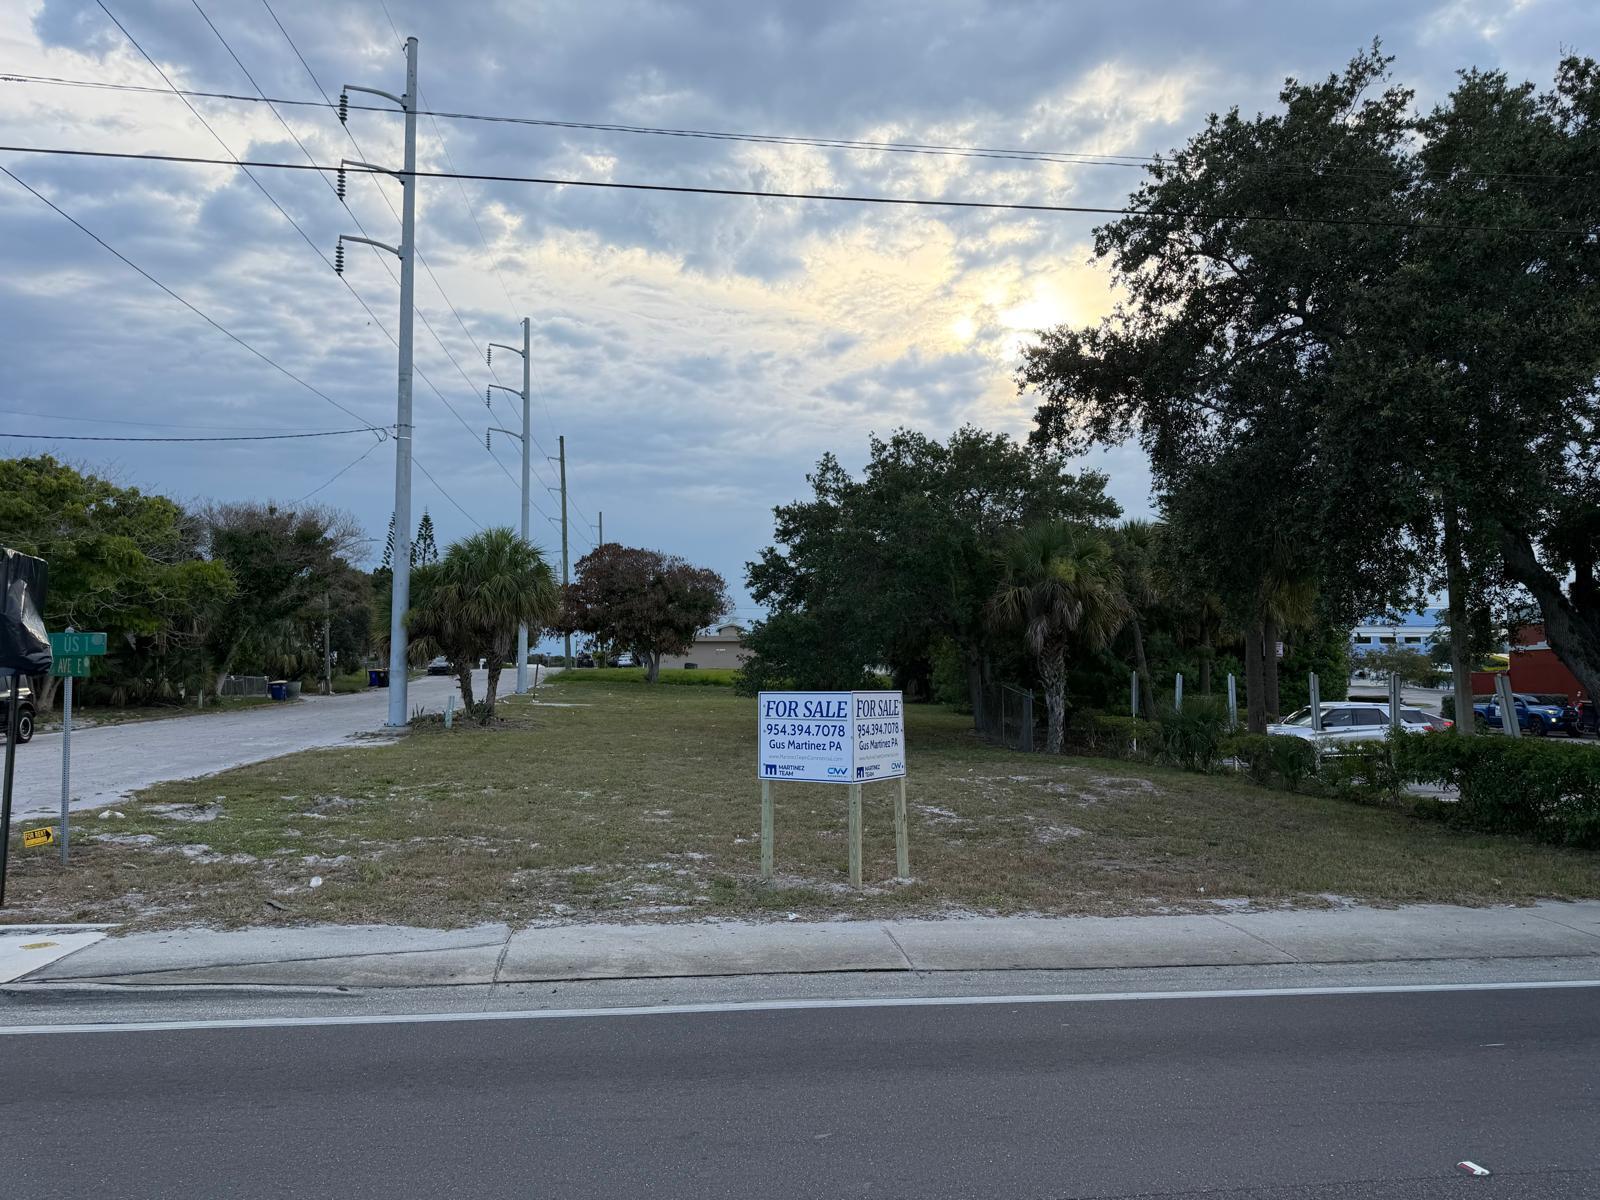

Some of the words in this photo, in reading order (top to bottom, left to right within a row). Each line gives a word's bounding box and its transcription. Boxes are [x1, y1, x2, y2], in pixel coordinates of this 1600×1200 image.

[64, 636, 79, 652] US
[85, 636, 89, 651] 1
[57, 657, 72, 673] AVE
[77, 657, 83, 673] E
[765, 700, 799, 717] FOR
[803, 700, 848, 718] SALE
[856, 698, 876, 718] FOR
[878, 699, 900, 717] SALE
[766, 723, 846, 738] 954.394.7078
[857, 721, 899, 737] 954.394.7078
[769, 739, 786, 750] Gus
[787, 739, 827, 751] Martinez
[829, 741, 843, 751] PA
[859, 740, 870, 751] Gus
[870, 739, 891, 750] Martinez
[891, 737, 899, 747] PA
[778, 764, 805, 772] MARTINEZ
